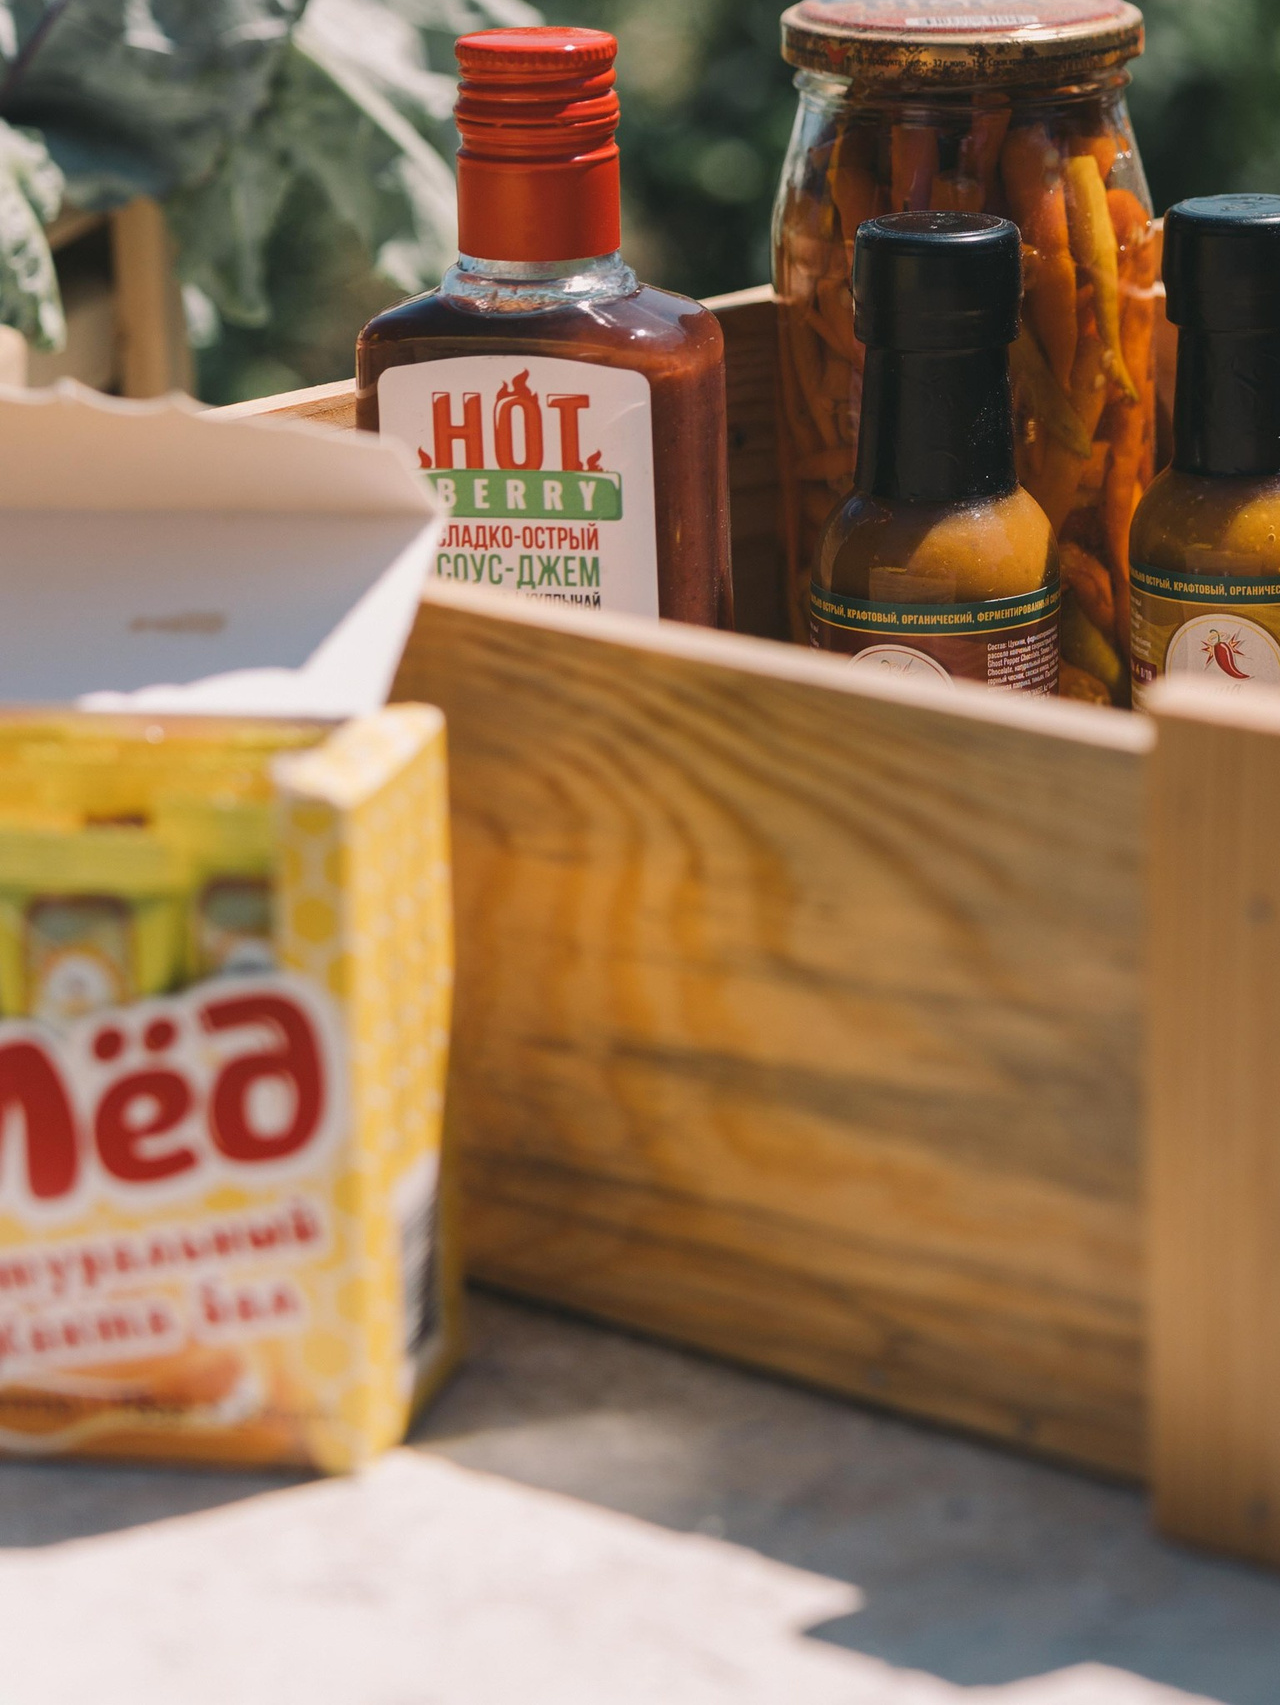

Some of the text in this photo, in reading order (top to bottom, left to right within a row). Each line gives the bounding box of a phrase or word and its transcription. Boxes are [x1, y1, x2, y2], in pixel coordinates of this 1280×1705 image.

[432, 391, 590, 472] HOT
[437, 478, 597, 512] BERRY
[436, 552, 601, 590] СОУС-ДЖЕМ
[1146, 574, 1173, 592] ОСТРЫЙ,
[1173, 581, 1228, 597] КРАФТОВЫЙ,
[847, 607, 900, 625] КРАФТОВЫЙ,
[901, 610, 975, 625] ОРГАНИЧЕСКИЙ,
